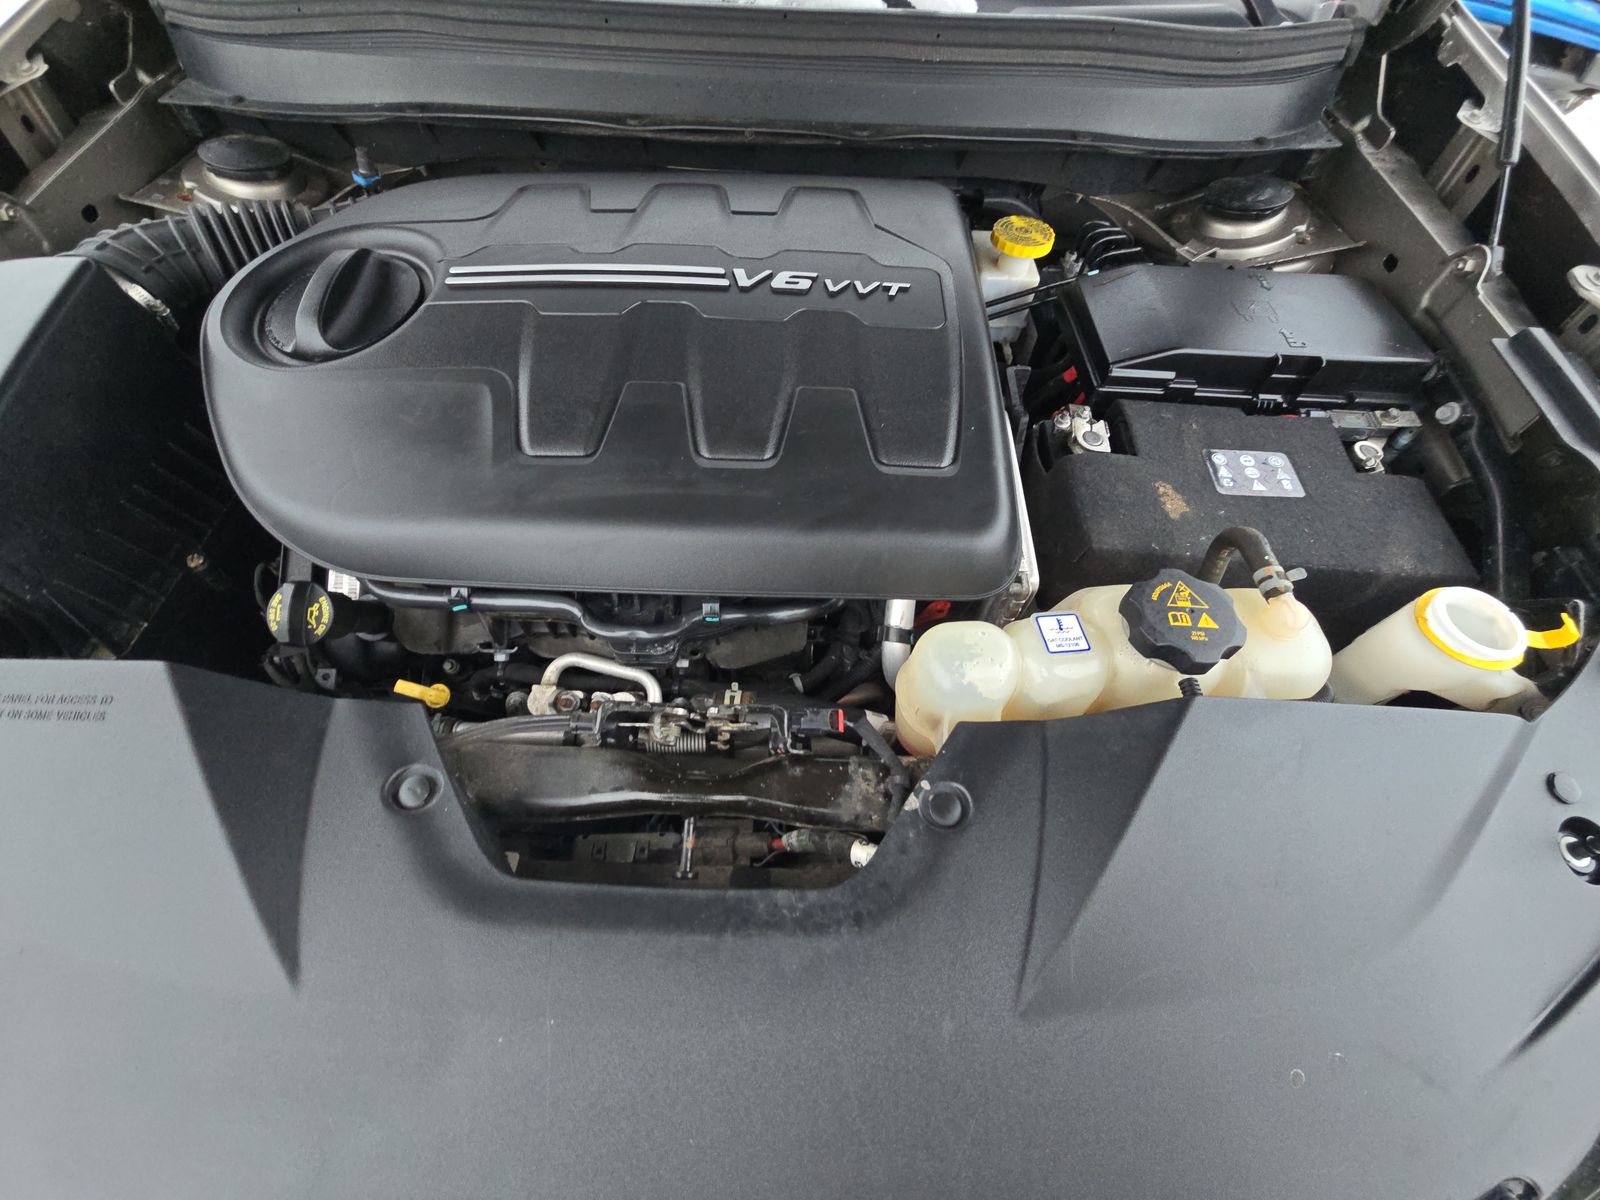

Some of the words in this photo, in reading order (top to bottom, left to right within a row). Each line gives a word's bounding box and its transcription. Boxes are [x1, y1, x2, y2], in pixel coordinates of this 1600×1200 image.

[732, 268, 819, 294] V6
[824, 278, 911, 299] VVT
[319, 596, 329, 624] ENGINE
[34, 694, 56, 705] FOR
[56, 694, 98, 705] ACCESS
[7, 709, 23, 719] ON
[23, 710, 54, 720] SOME
[56, 710, 106, 720] VEHICLES
